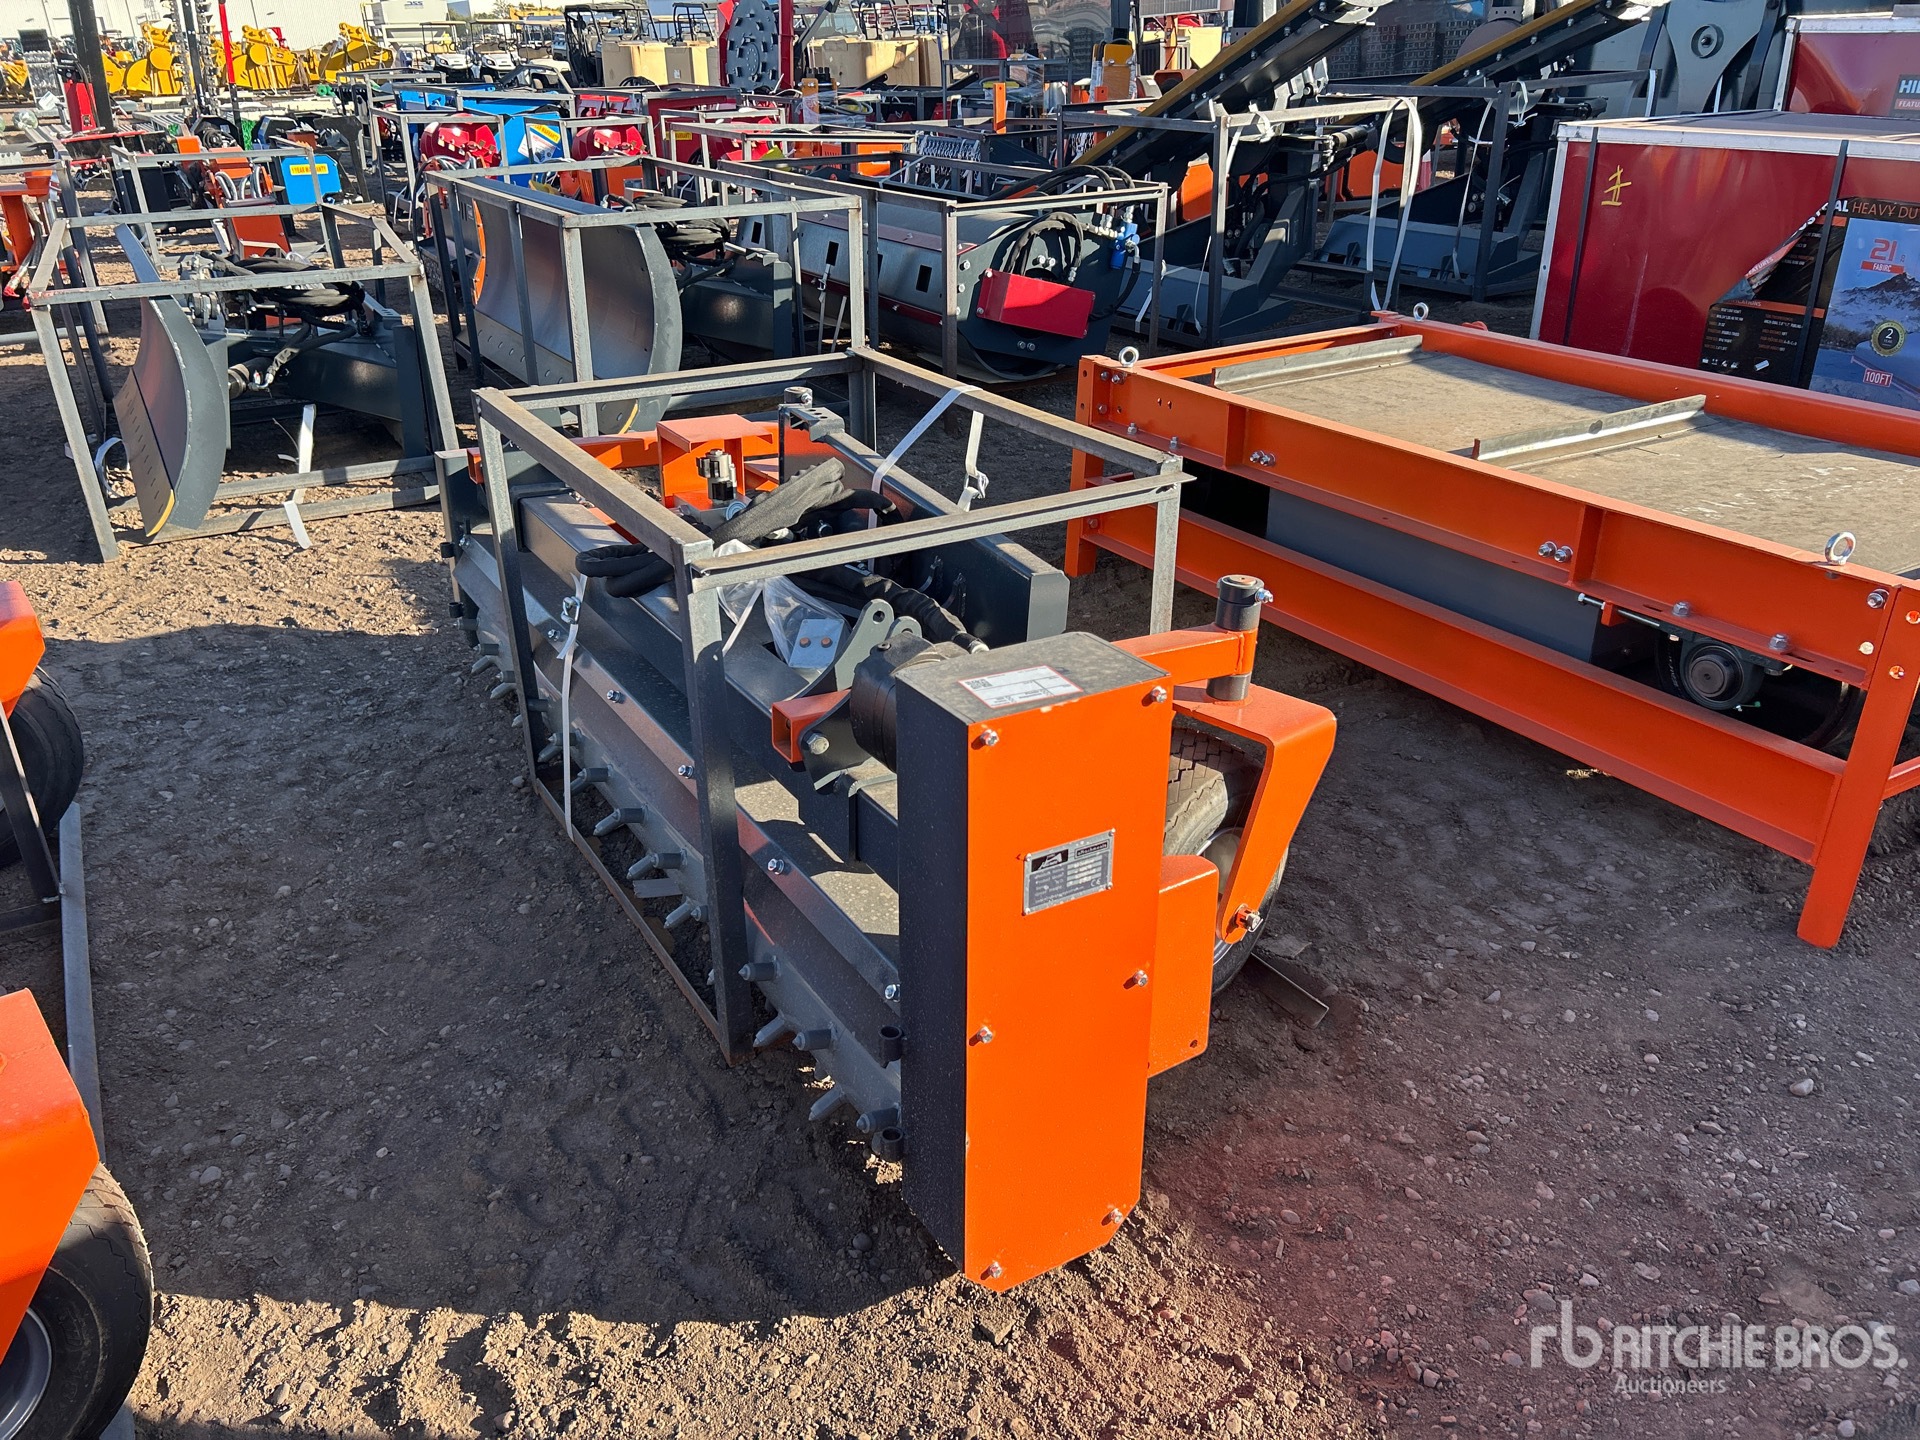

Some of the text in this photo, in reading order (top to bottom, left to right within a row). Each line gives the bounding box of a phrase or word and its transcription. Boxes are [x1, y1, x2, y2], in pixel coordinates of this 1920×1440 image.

[1898, 100, 1920, 108] FEATU
[1898, 206, 1920, 219] DU
[1869, 238, 1898, 262] 21
[1885, 328, 1894, 339] 2
[1865, 371, 1891, 386] 100FT
